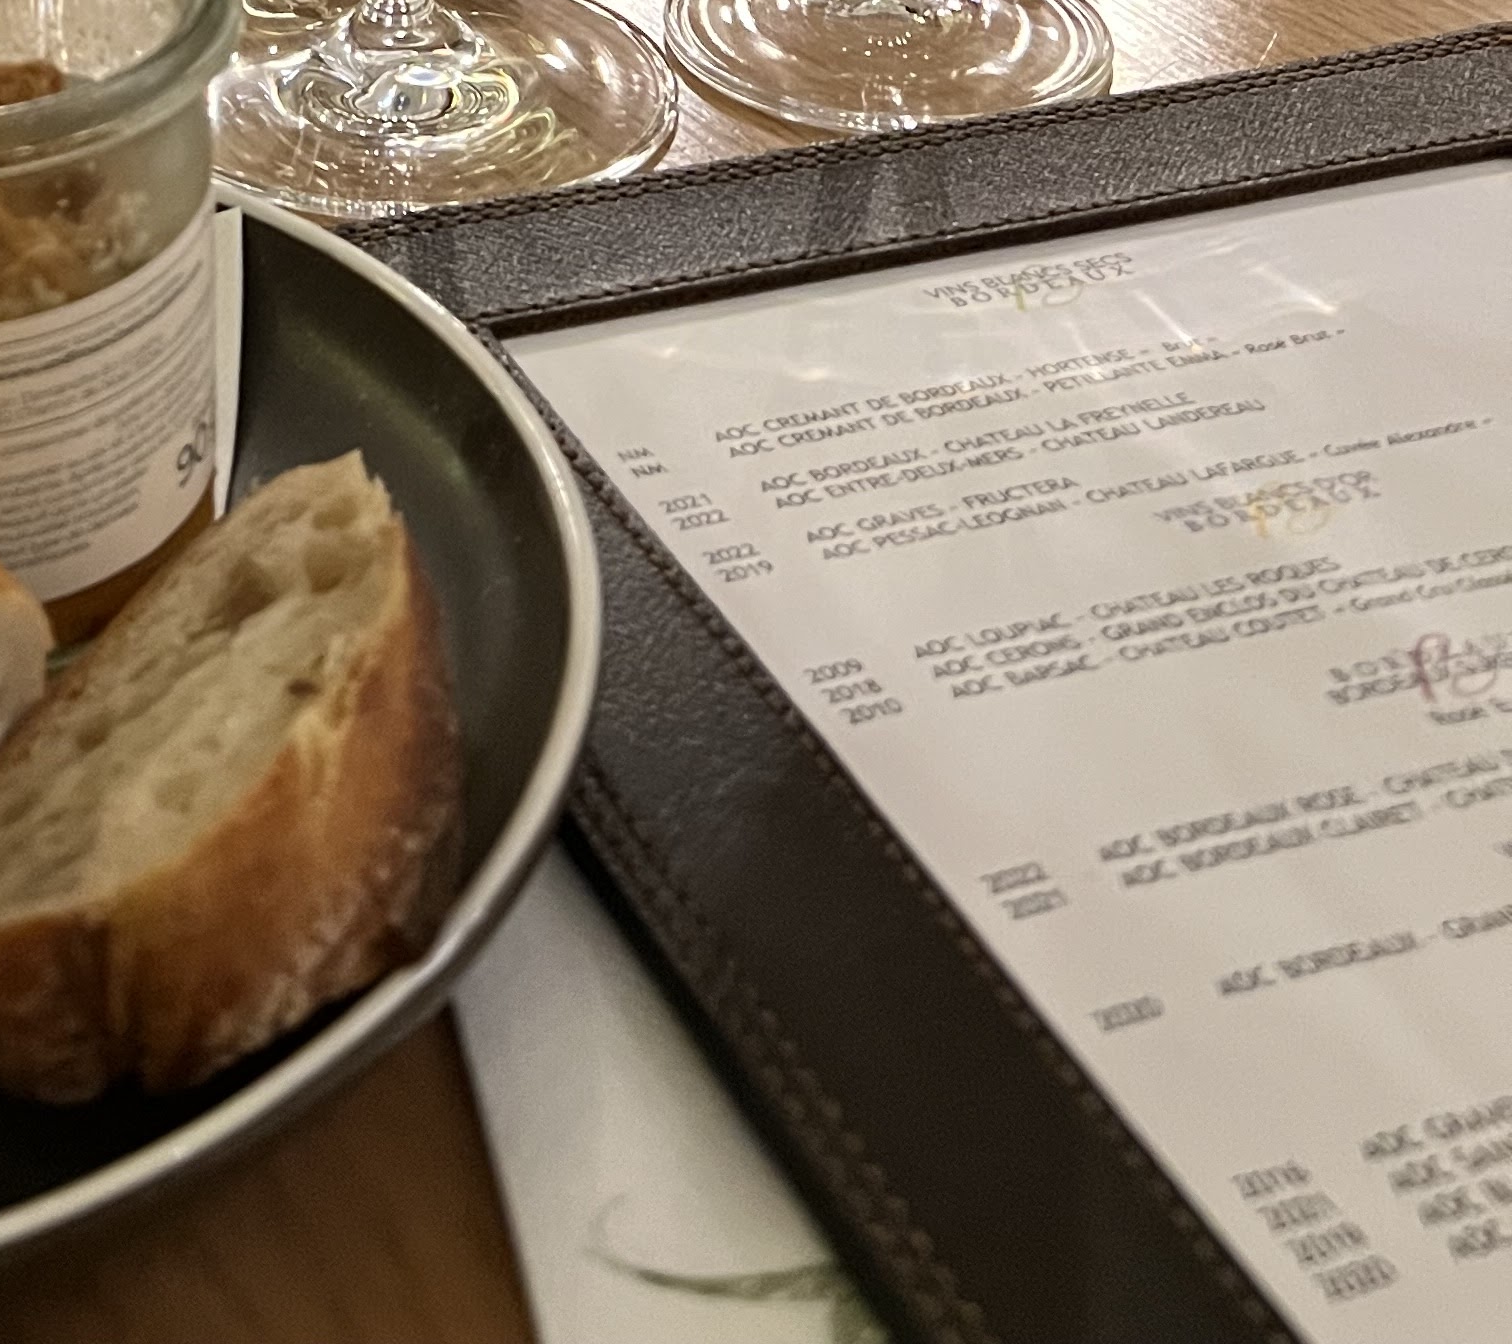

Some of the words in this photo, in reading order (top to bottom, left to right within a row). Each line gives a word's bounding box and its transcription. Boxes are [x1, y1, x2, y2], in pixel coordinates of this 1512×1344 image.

[923, 280, 981, 299] VINS
[980, 263, 1073, 290] BLANCS
[1072, 252, 1133, 273] SECS
[949, 264, 1134, 308] BORDEAUX
[715, 423, 761, 443] AOC
[762, 401, 860, 432] CREMANT
[865, 395, 899, 412] DE
[898, 374, 1012, 405] BORDEAUX
[1025, 348, 1135, 378] HORTENSE
[729, 438, 775, 458] AOC
[777, 417, 876, 448] CREMANT
[880, 410, 914, 427] DE
[913, 388, 1028, 420] BORDEAUX
[1042, 360, 1167, 393] PETILLANTE
[1164, 350, 1229, 368] EMMA
[658, 493, 713, 514] 2021
[760, 472, 808, 493] AOC
[808, 447, 927, 483] BORDEAUX
[943, 423, 1045, 454] CHATEAU
[1045, 418, 1079, 432] LA
[1076, 391, 1196, 426] FREYNELLE
[672, 508, 730, 531] 2022
[775, 488, 823, 509] AOC
[823, 446, 1024, 498] ENTRE-DEUX-MERS
[1040, 422, 1142, 452] CHATEAU
[1141, 399, 1266, 431] LANDEREAU
[702, 543, 761, 566] 2022
[806, 522, 855, 544] AOC
[855, 503, 945, 532] GRAVES
[961, 477, 1079, 509] FRUCTERA
[717, 560, 774, 583] 2019
[822, 539, 871, 561] AOC
[871, 499, 1068, 549] PESSAC-LEOGNAN
[1085, 472, 1189, 504] CHATEAU
[1189, 449, 1305, 481] LAFARGUE
[1153, 500, 1215, 523] VINS
[804, 659, 863, 684] 2009
[914, 636, 966, 659] AOC
[966, 613, 1073, 647] LOUPIAC
[1089, 586, 1201, 621] CHATEAU
[1201, 576, 1247, 598] LES
[1244, 556, 1342, 586] ROQUES
[933, 655, 985, 679] AOC
[1100, 613, 1185, 642] GRAND
[951, 674, 1003, 699] AOC
[1117, 628, 1231, 662] CHATEAU
[1099, 834, 1155, 863] AOC
[1121, 859, 1177, 889] AOC
